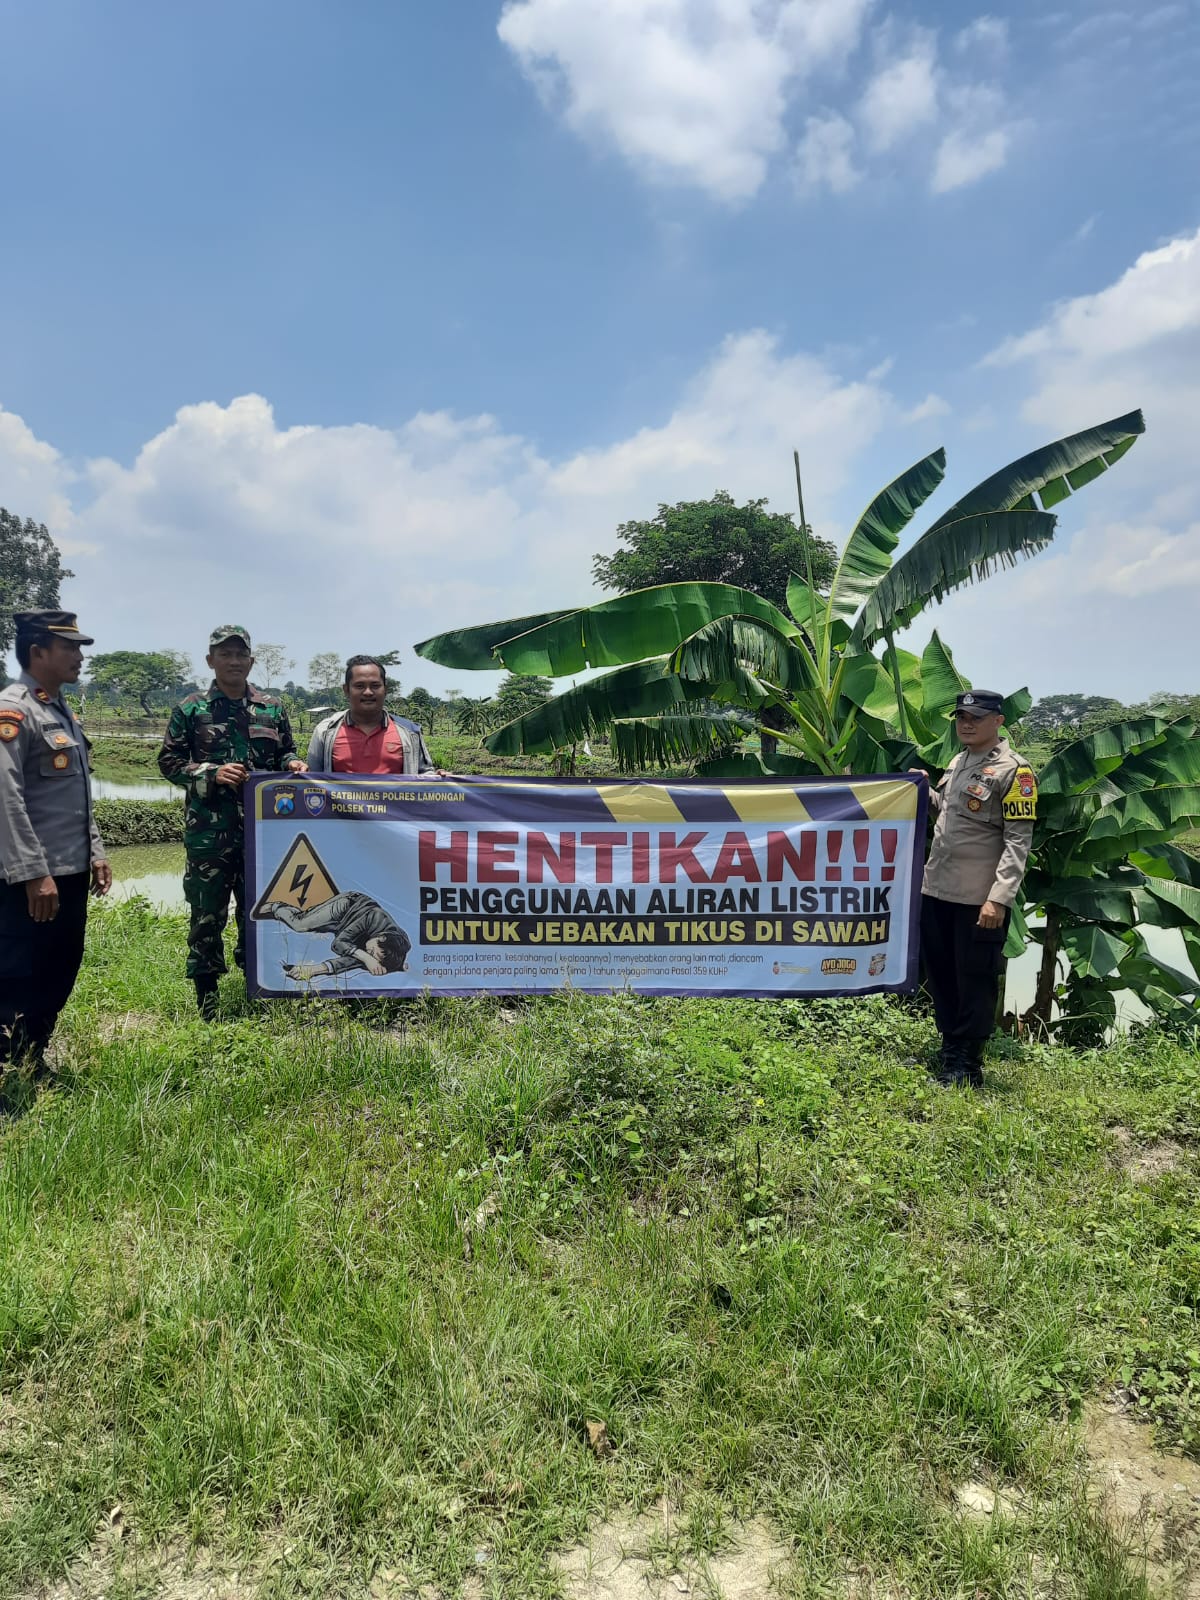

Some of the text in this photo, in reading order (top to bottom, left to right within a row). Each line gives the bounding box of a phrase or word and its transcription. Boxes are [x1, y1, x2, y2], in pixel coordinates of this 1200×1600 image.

[331, 791, 379, 800] SATBINMAS
[382, 792, 415, 801] POLRES
[417, 792, 465, 801] LAMONGAN
[331, 804, 386, 813] POLSEK TURI
[1003, 801, 1032, 816] POLISI
[419, 829, 897, 883] HENTIKAN!!!
[419, 886, 891, 914] PENGGUNAAN ALIRAN LISTRIK
[425, 919, 887, 943] UNTUK JEBAKAN TIKUS DI SAWAH
[423, 953, 450, 965] Barang
[452, 952, 474, 965] siapa
[475, 953, 502, 962] karena
[613, 953, 667, 965] menyebabkan
[668, 953, 691, 965] orang
[692, 952, 707, 962] lain
[708, 953, 726, 962] mati
[423, 967, 453, 977] dengan
[454, 966, 481, 978] pidana
[482, 967, 512, 979] penjara
[514, 966, 538, 978] paling
[539, 966, 559, 975] lama
[593, 967, 616, 976] tahun
[671, 966, 692, 976] Pasal
[693, 966, 708, 976] 359
[708, 966, 729, 976] KUHP
